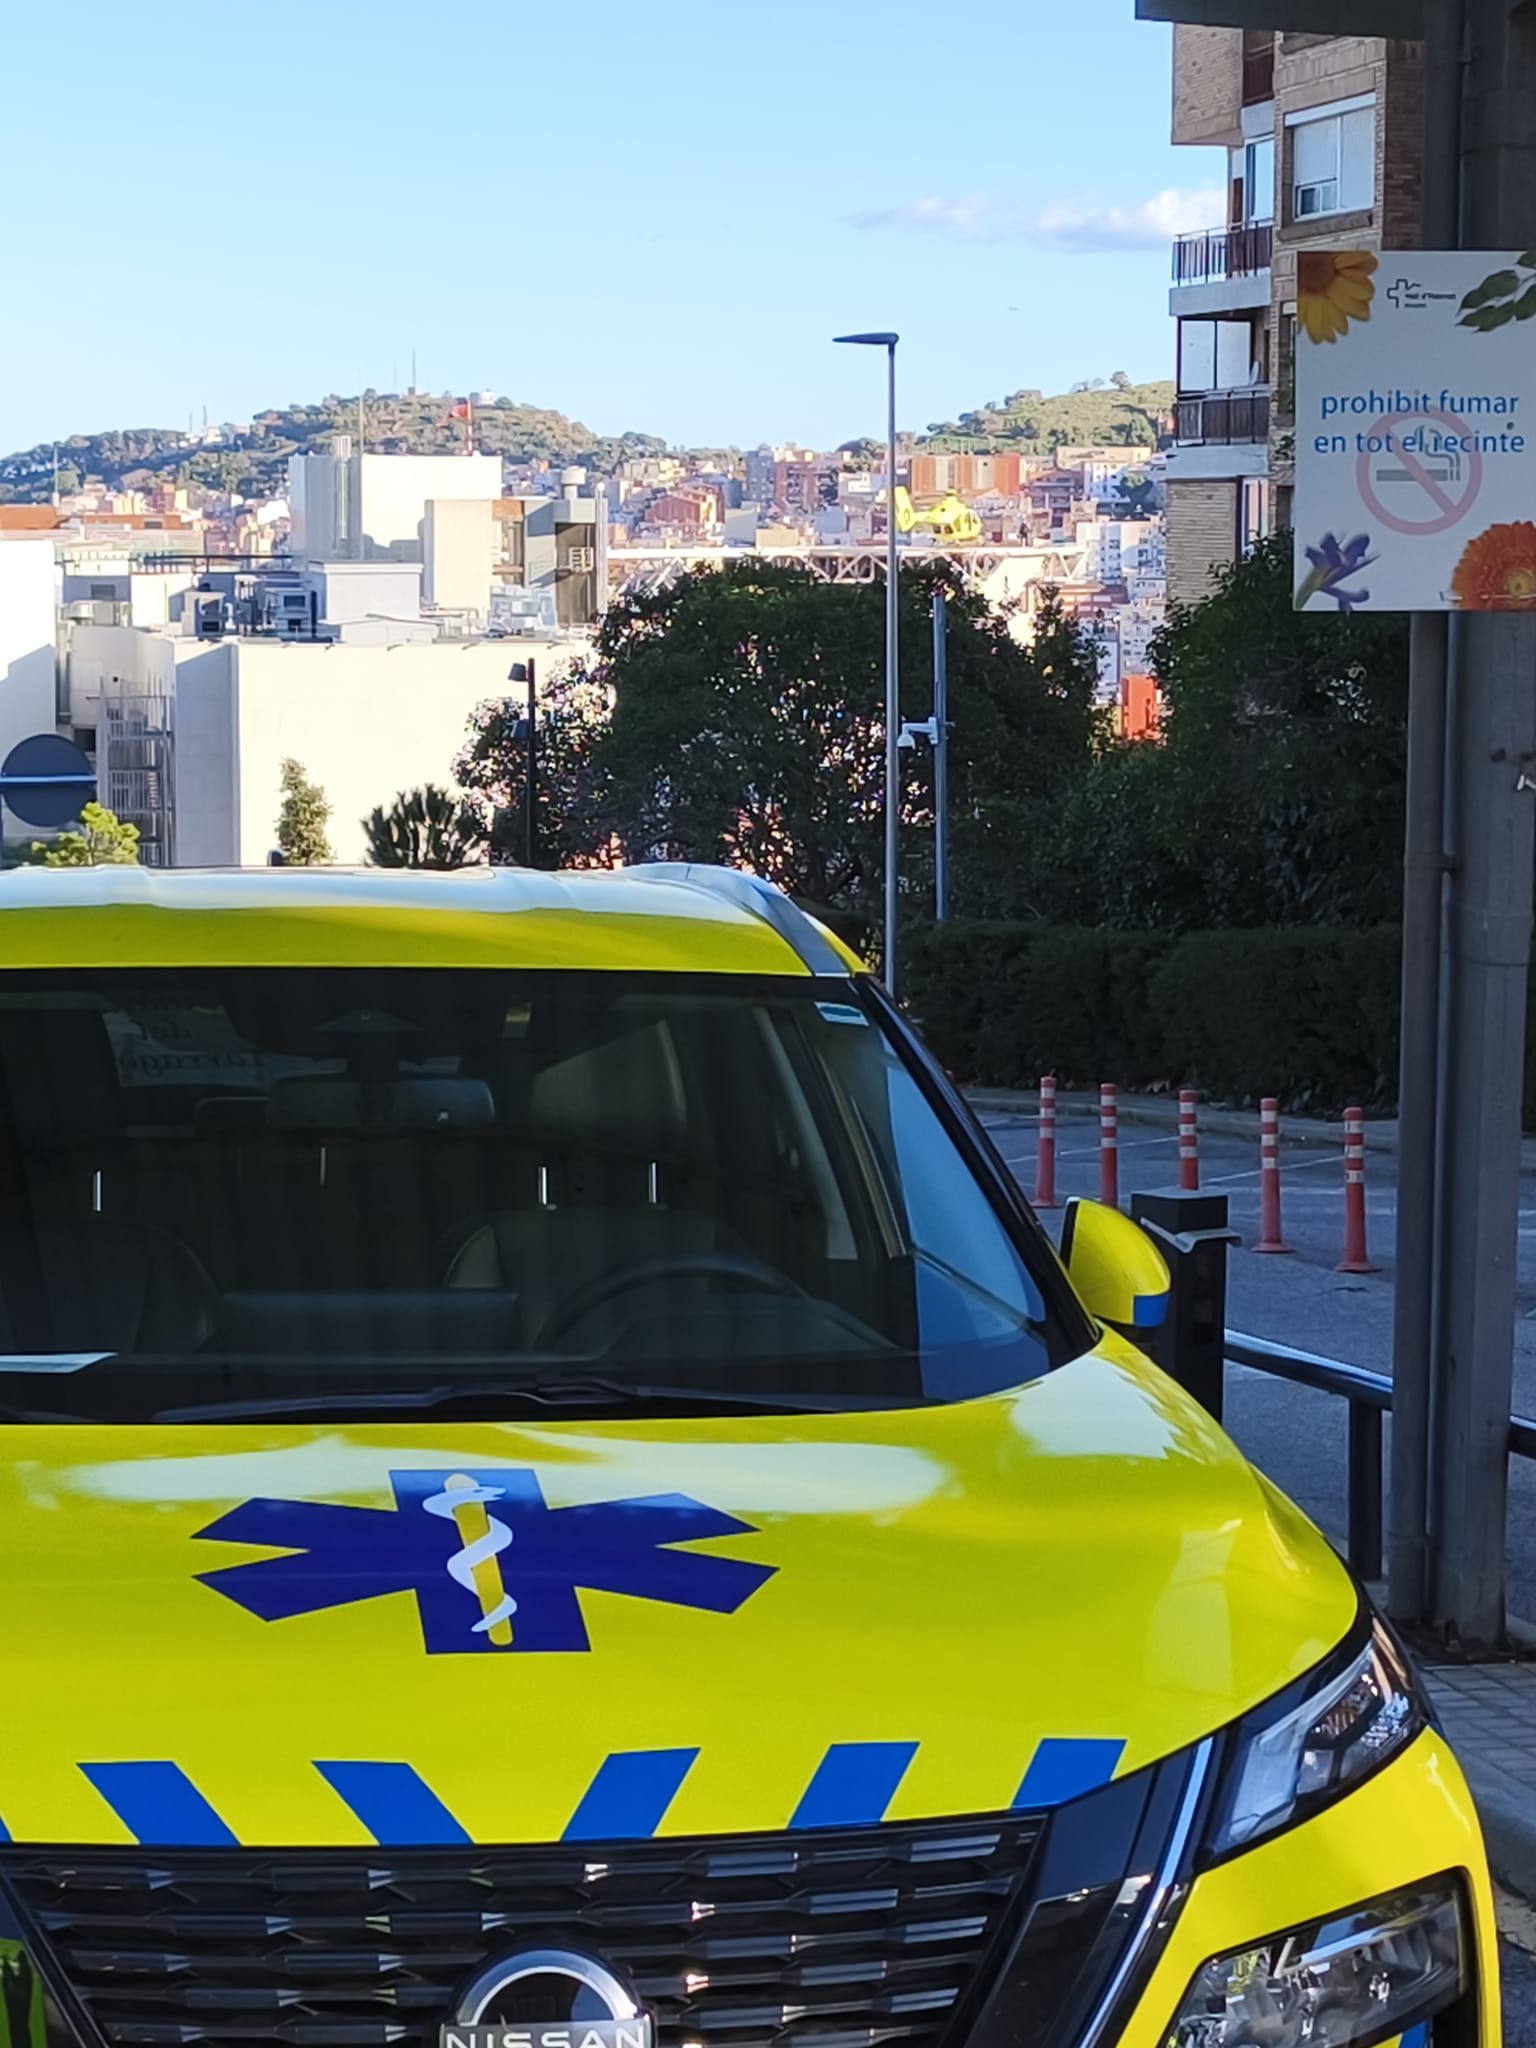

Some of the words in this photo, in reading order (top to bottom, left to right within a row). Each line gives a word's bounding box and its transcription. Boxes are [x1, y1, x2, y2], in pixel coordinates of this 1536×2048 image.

[1321, 389, 1430, 420] prohibit
[1439, 389, 1519, 414] fumar
[1314, 434, 1346, 453] en
[1356, 432, 1393, 453] tot
[1402, 425, 1424, 453] el
[1433, 430, 1525, 453] recinte
[446, 2028, 644, 2048] NISSAN
